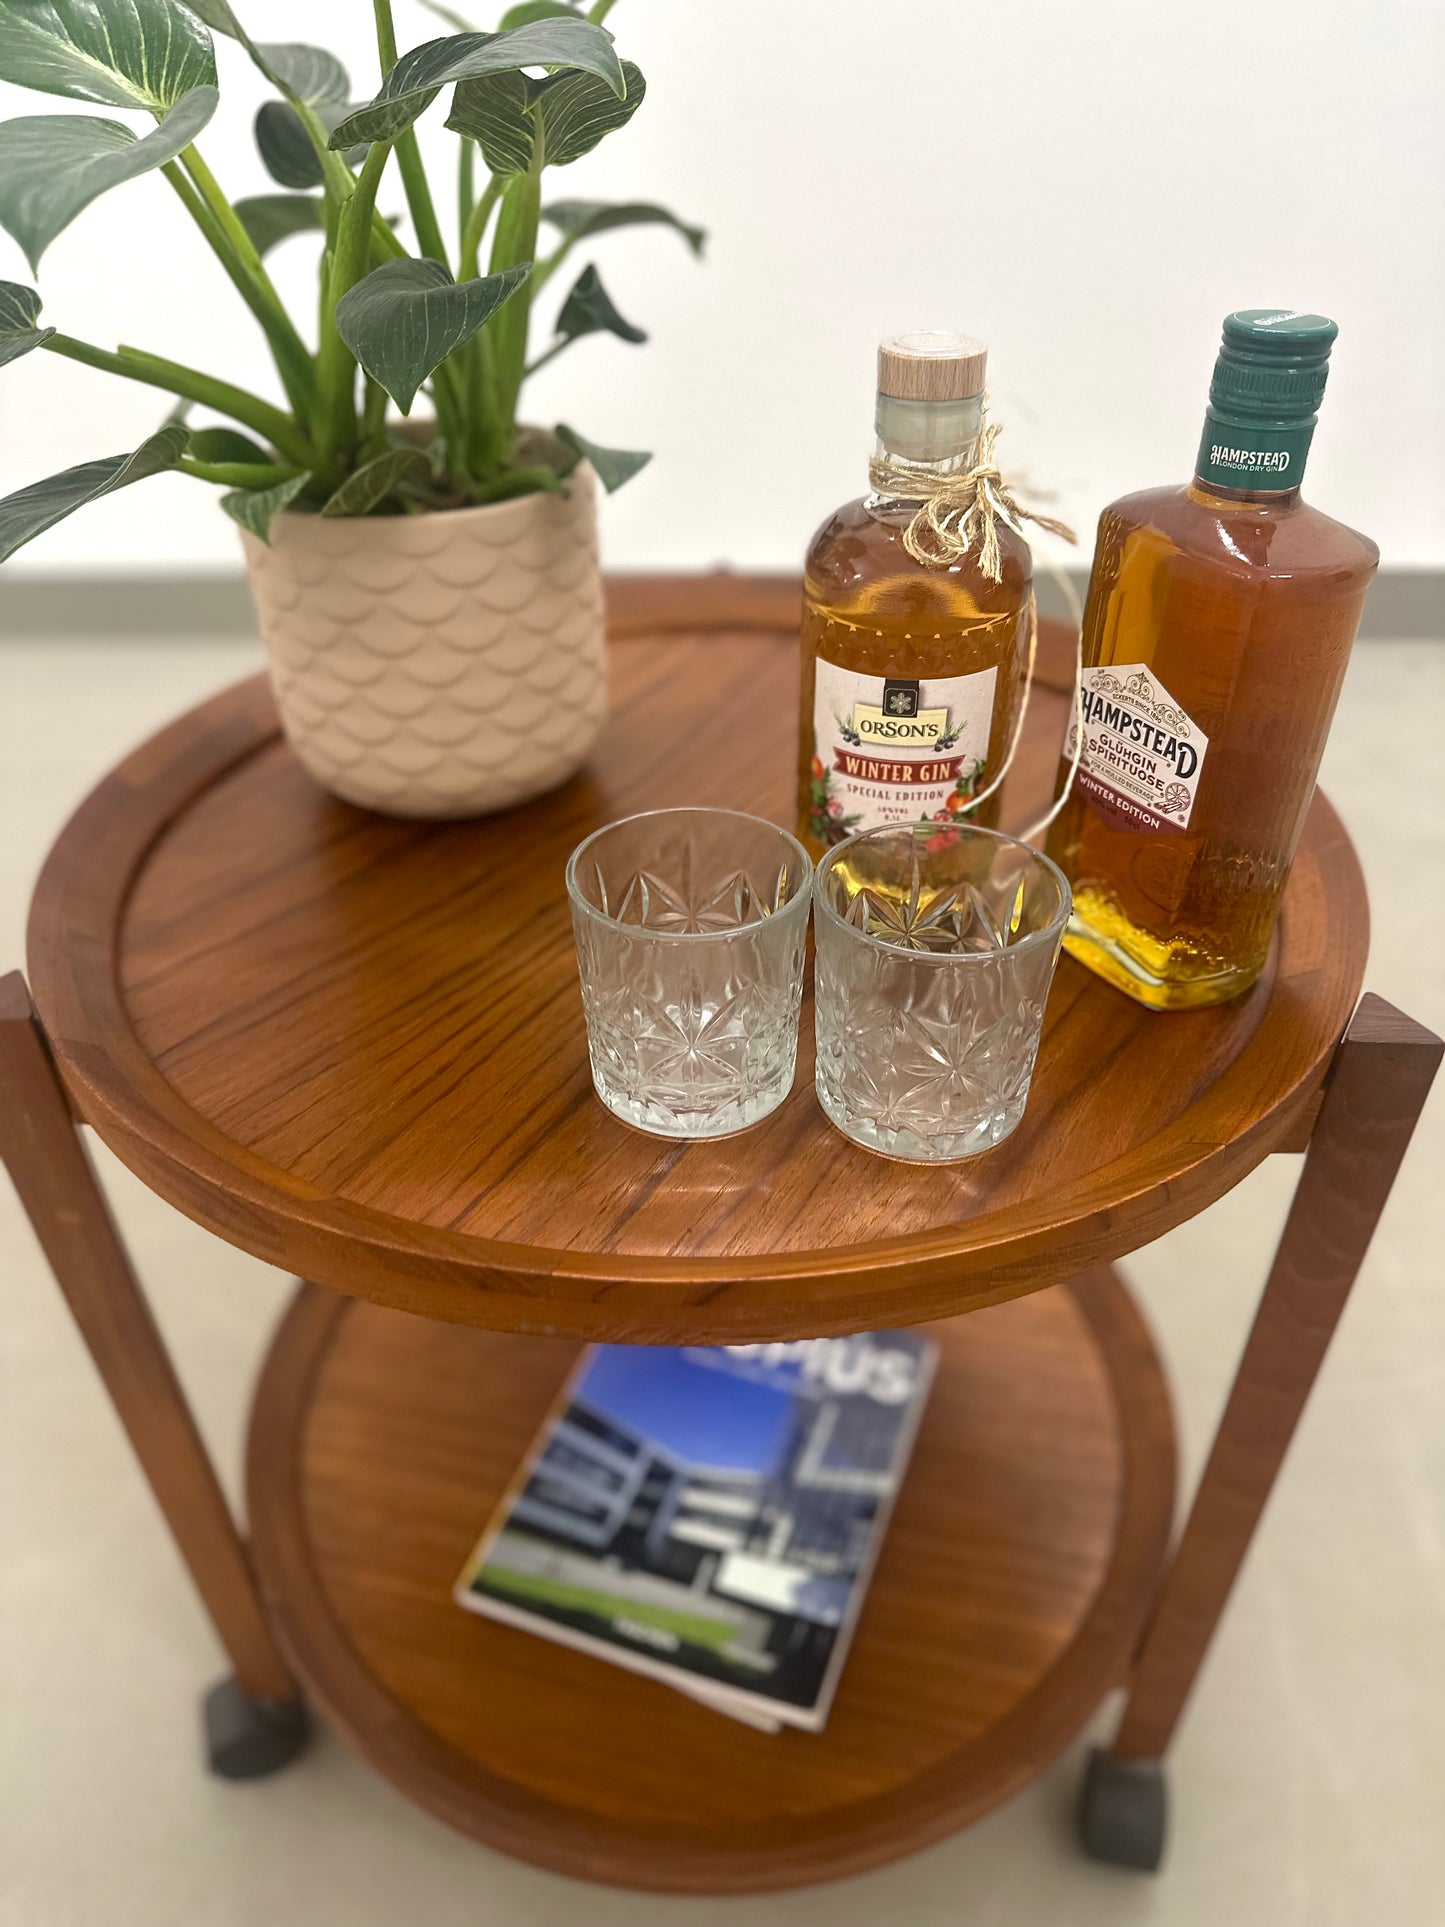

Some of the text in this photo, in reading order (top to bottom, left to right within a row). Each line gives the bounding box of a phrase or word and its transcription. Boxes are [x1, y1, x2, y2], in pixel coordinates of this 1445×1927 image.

[1210, 444, 1290, 472] HAMPSTEAD
[1219, 460, 1248, 471] LONDON
[1079, 686, 1198, 779] HAMPSTEAD
[846, 756, 951, 781] WINTER GIN
[1088, 739, 1166, 792] SPIRITUOSE
[1099, 733, 1157, 774] GLÜHGIN
[847, 783, 945, 801] SPECIAL EDITION
[1079, 773, 1115, 804] WINTER
[1116, 797, 1160, 830] EDITION
